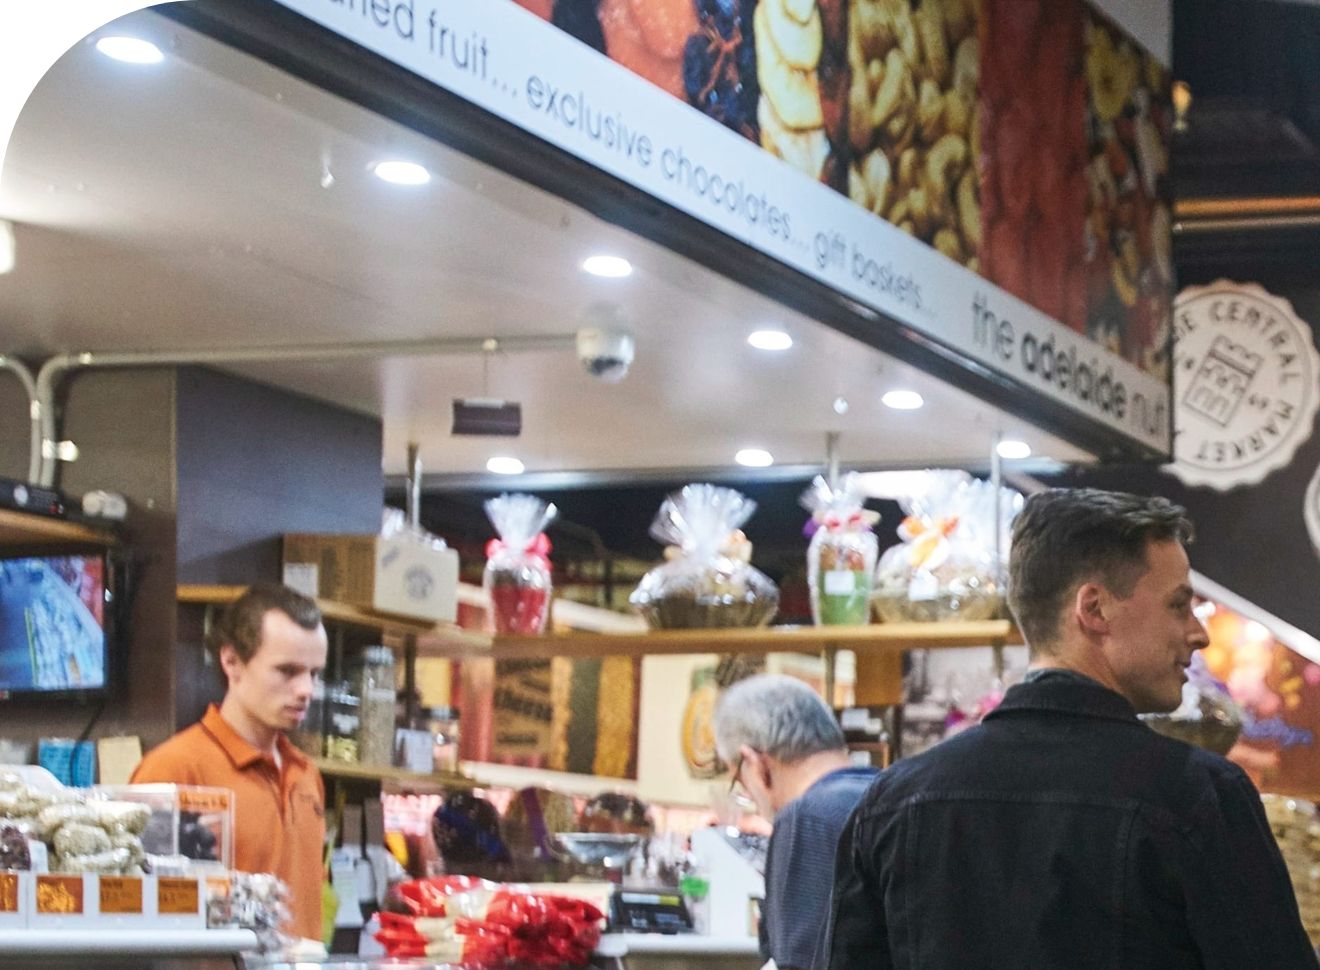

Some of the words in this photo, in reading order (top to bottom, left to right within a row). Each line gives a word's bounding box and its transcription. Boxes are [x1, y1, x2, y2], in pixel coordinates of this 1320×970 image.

[526, 74, 653, 167] exclusive
[813, 230, 847, 270] gift
[972, 291, 1015, 360] the
[1021, 331, 1128, 420] adelaide
[1209, 301, 1300, 386] CENTRAL
[1196, 400, 1294, 463] MARKET
